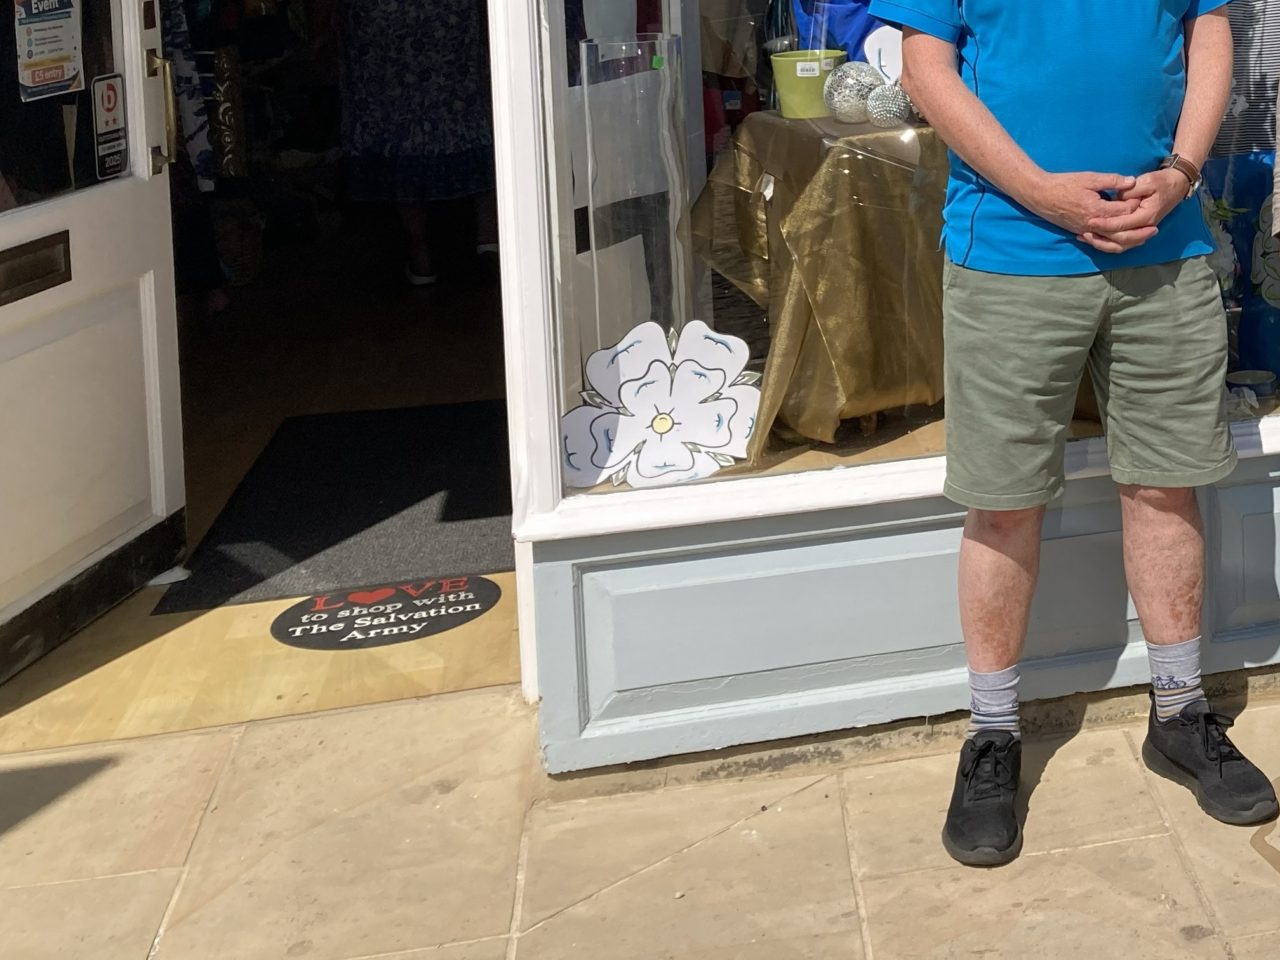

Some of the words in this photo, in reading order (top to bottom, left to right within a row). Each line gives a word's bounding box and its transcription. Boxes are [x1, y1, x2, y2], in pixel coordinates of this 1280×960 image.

[288, 622, 344, 637] The
[354, 602, 482, 628] Salvation
[300, 612, 328, 623] to
[337, 602, 402, 619] shop
[413, 591, 474, 606] with
[339, 621, 428, 642] Army
